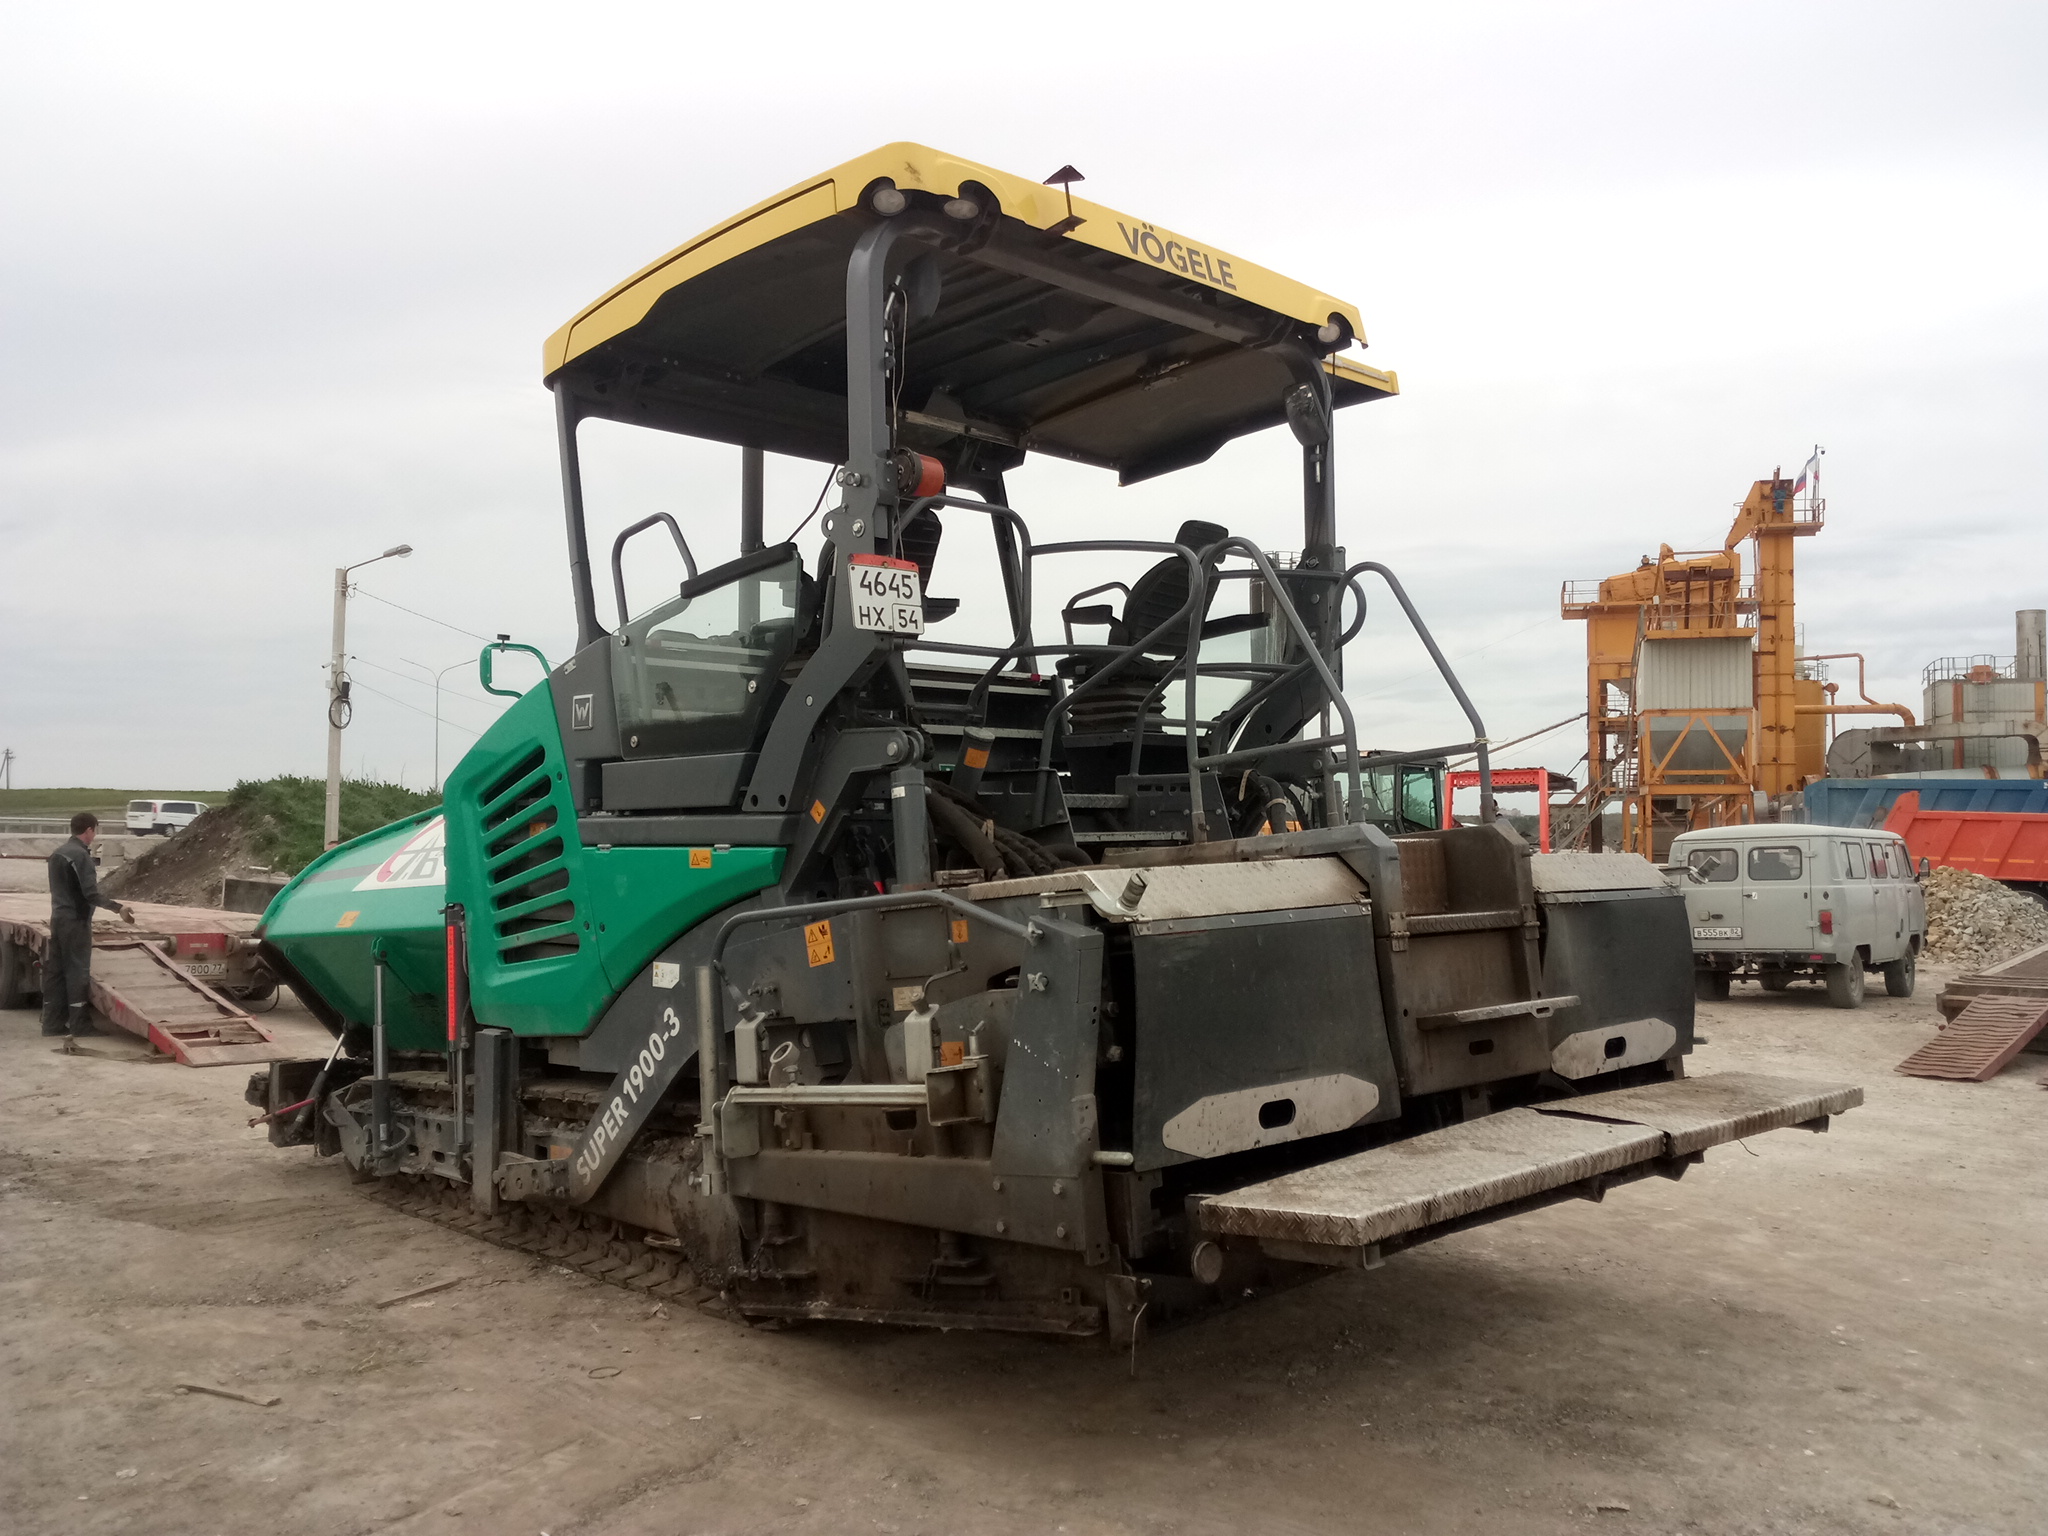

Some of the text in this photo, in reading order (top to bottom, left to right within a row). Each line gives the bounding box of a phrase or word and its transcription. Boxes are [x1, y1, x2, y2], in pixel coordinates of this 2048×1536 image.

[1116, 221, 1237, 291] VÖGELE
[859, 570, 913, 599] 4645
[898, 608, 918, 630] 54
[576, 1096, 629, 1186] SUPER
[622, 1007, 680, 1104] 1900-3
